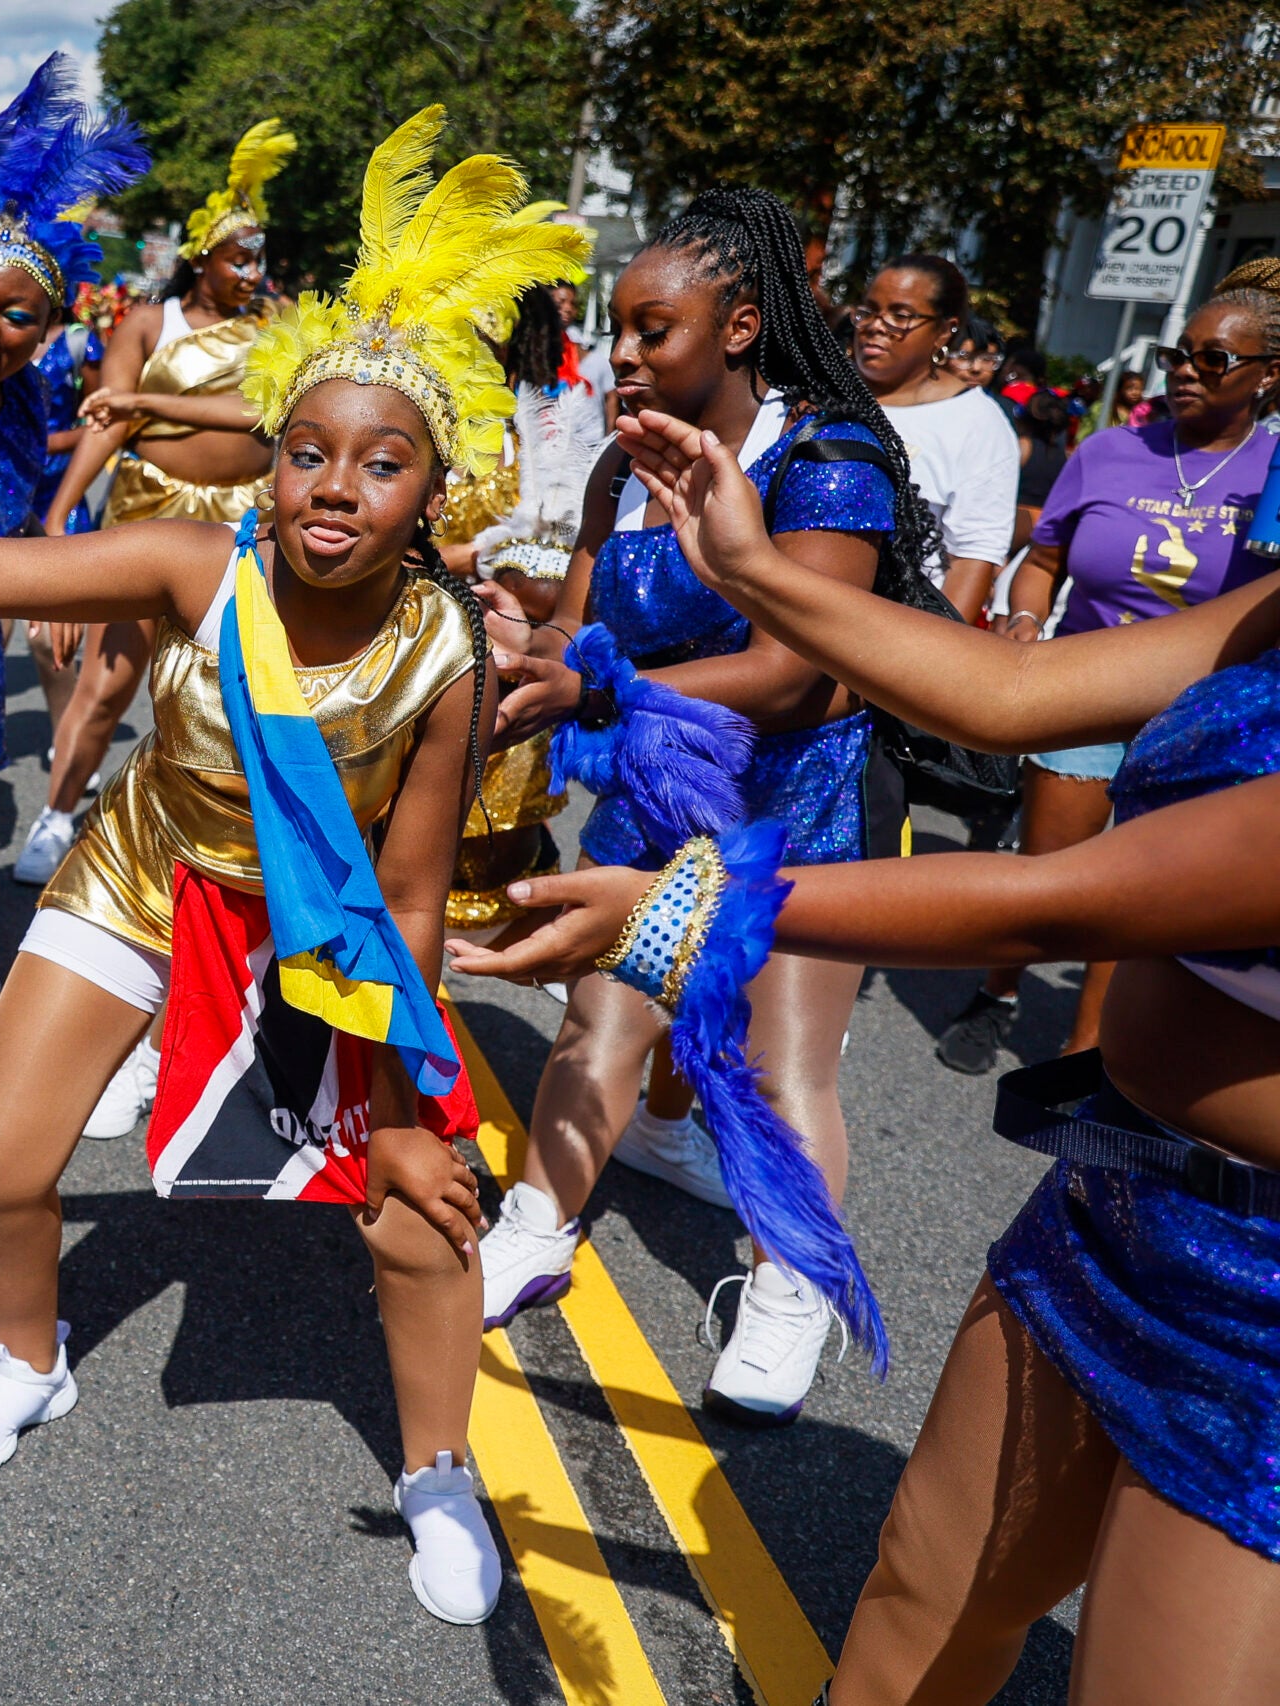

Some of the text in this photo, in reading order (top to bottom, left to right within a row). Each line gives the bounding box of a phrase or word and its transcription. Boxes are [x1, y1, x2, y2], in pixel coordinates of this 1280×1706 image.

[1128, 134, 1208, 162] SCHOOL
[1129, 175, 1200, 191] SPEED
[1126, 193, 1188, 209] LIMIT
[1111, 216, 1186, 257] 20
[1136, 498, 1172, 516] STAR
